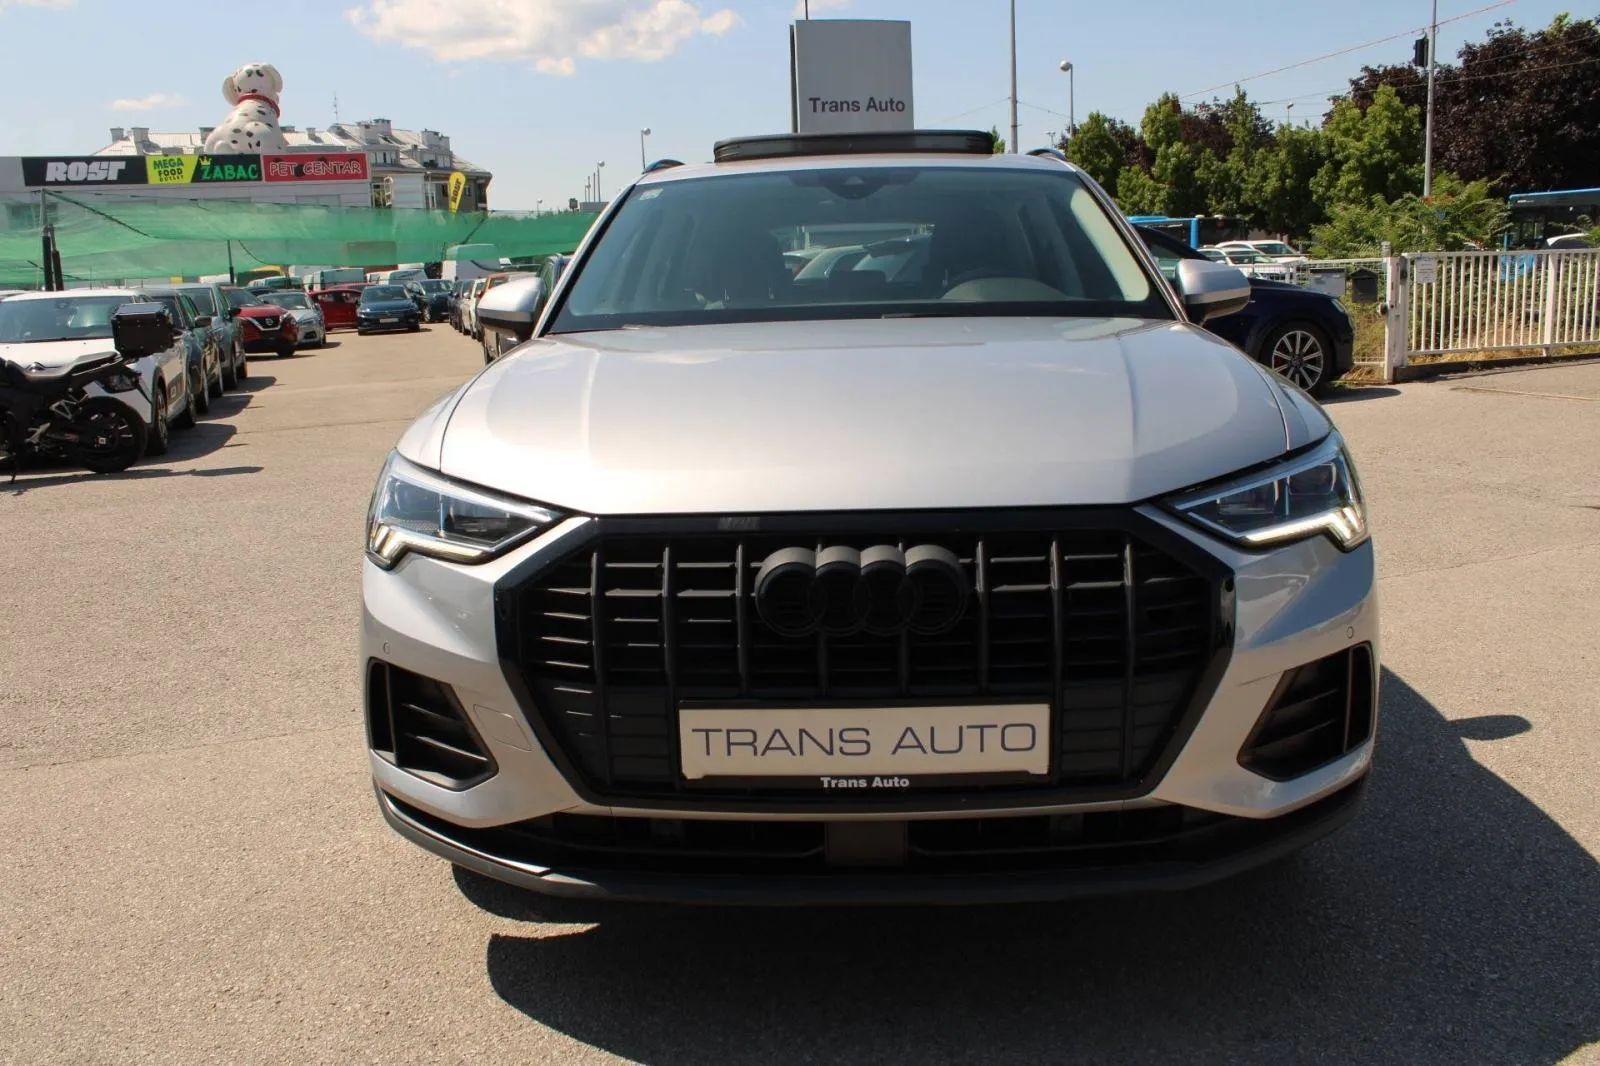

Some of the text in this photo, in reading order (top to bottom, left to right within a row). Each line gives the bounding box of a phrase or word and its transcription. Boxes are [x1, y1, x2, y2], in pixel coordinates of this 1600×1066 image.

[808, 97, 906, 113] Trans Auto
[45, 161, 126, 181] ROST
[153, 158, 185, 170] MEGA
[269, 160, 362, 177] PET CENTAR
[158, 168, 183, 177] FOOD
[691, 722, 1037, 757] TRANS AUTO
[820, 776, 910, 788] Trans Auto
